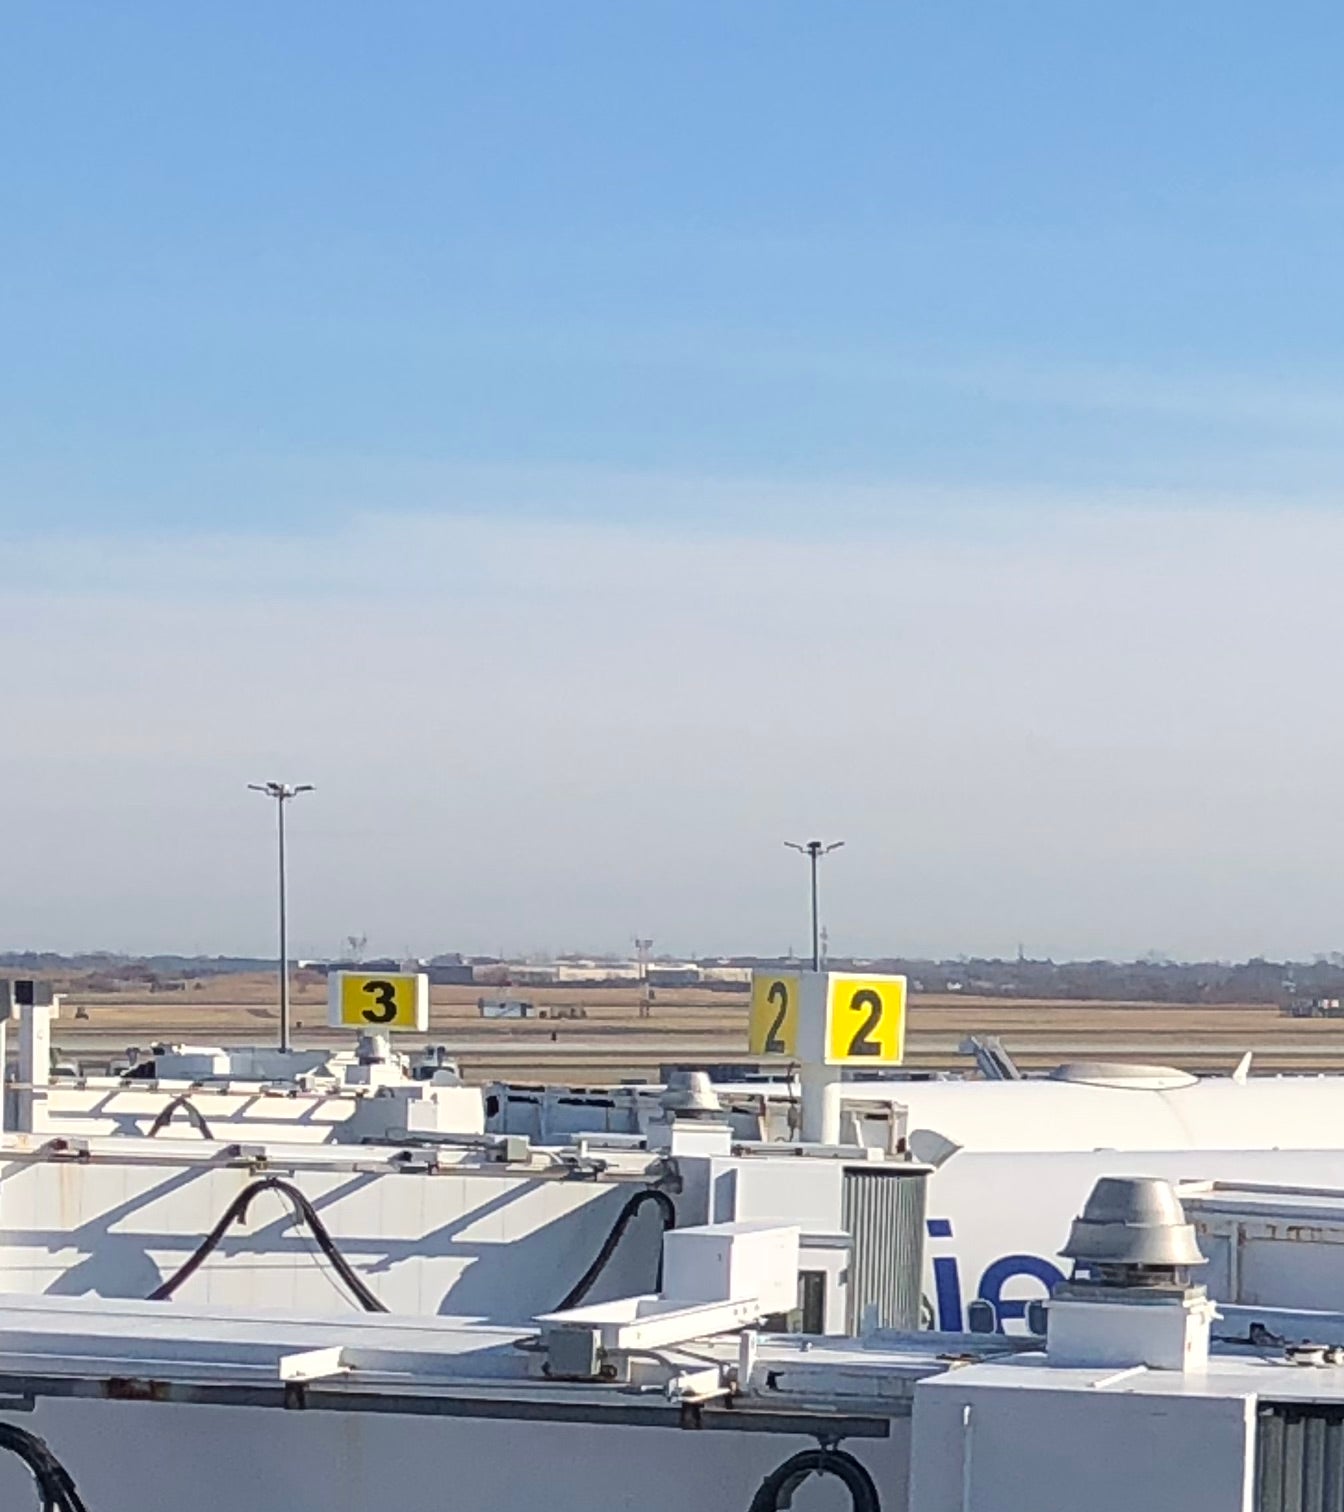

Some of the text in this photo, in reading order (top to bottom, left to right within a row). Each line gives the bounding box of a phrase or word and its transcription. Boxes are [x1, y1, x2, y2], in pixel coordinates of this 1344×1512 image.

[362, 980, 397, 1023] 3
[764, 981, 788, 1053] 2
[847, 989, 882, 1056] 2
